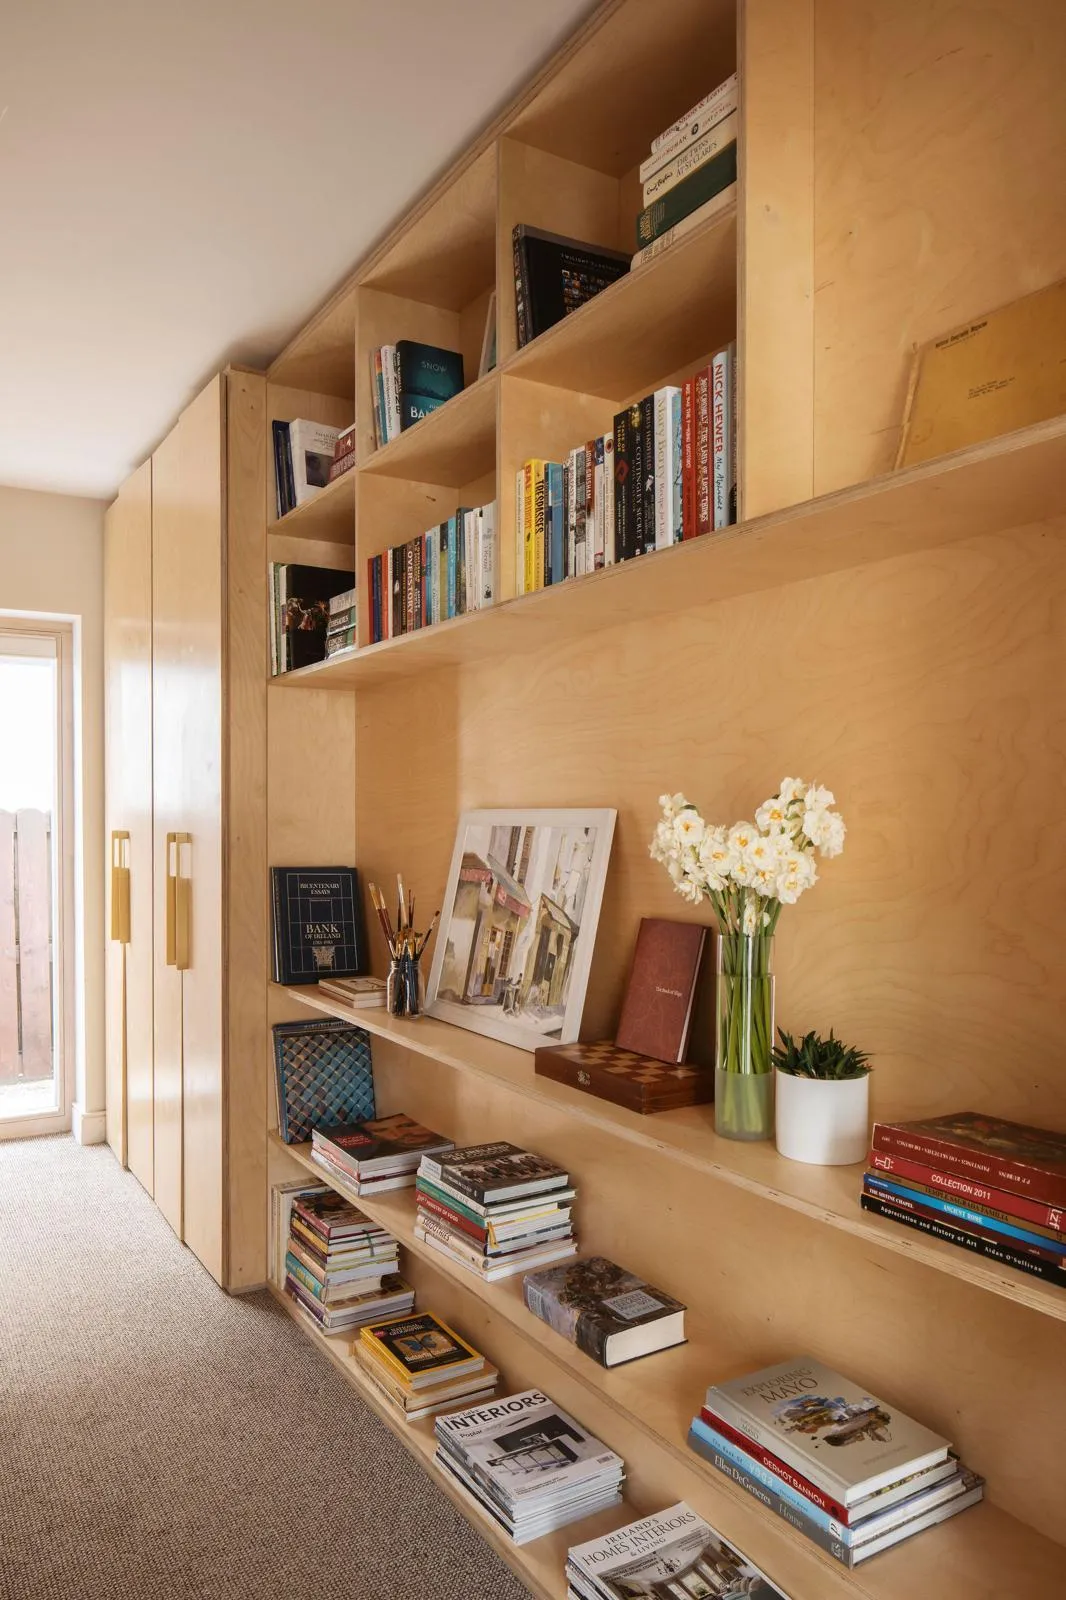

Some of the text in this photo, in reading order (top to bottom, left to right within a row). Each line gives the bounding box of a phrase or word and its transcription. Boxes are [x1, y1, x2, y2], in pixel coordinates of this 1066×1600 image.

[422, 361, 448, 372] SNOW
[714, 363, 723, 401] NICK
[657, 398, 666, 435] Mary
[714, 404, 723, 454] HEWER
[657, 440, 666, 479] Berry
[535, 479, 543, 534] TRESPASSES
[700, 496, 709, 521] THINGS
[306, 924, 339, 933] BANK
[961, 1159, 990, 1172] PAINTINGS
[931, 1174, 991, 1200] COLLECTION 2011
[895, 1196, 914, 1209] CHAPEL
[423, 1218, 450, 1241] SMOOTHIES
[880, 1206, 917, 1224] Appreciation
[919, 1219, 930, 1230] and
[932, 1224, 955, 1240] History
[966, 1237, 978, 1248] Art
[984, 1246, 1003, 1259] Aidan
[1006, 1253, 1043, 1273] O'Sullivan
[743, 1367, 812, 1397] EXPLORING
[760, 1378, 818, 1404] MAYO
[444, 1393, 547, 1431] INTERIORS
[715, 1455, 804, 1528] Ellen DeGeneres Home
[763, 1457, 825, 1507] DERMOT BANNON
[581, 1542, 630, 1566] HOMES
[629, 1512, 696, 1547] INTERIORS
[605, 1518, 659, 1545] IRELAND'S
[637, 1537, 666, 1554] LIVING
